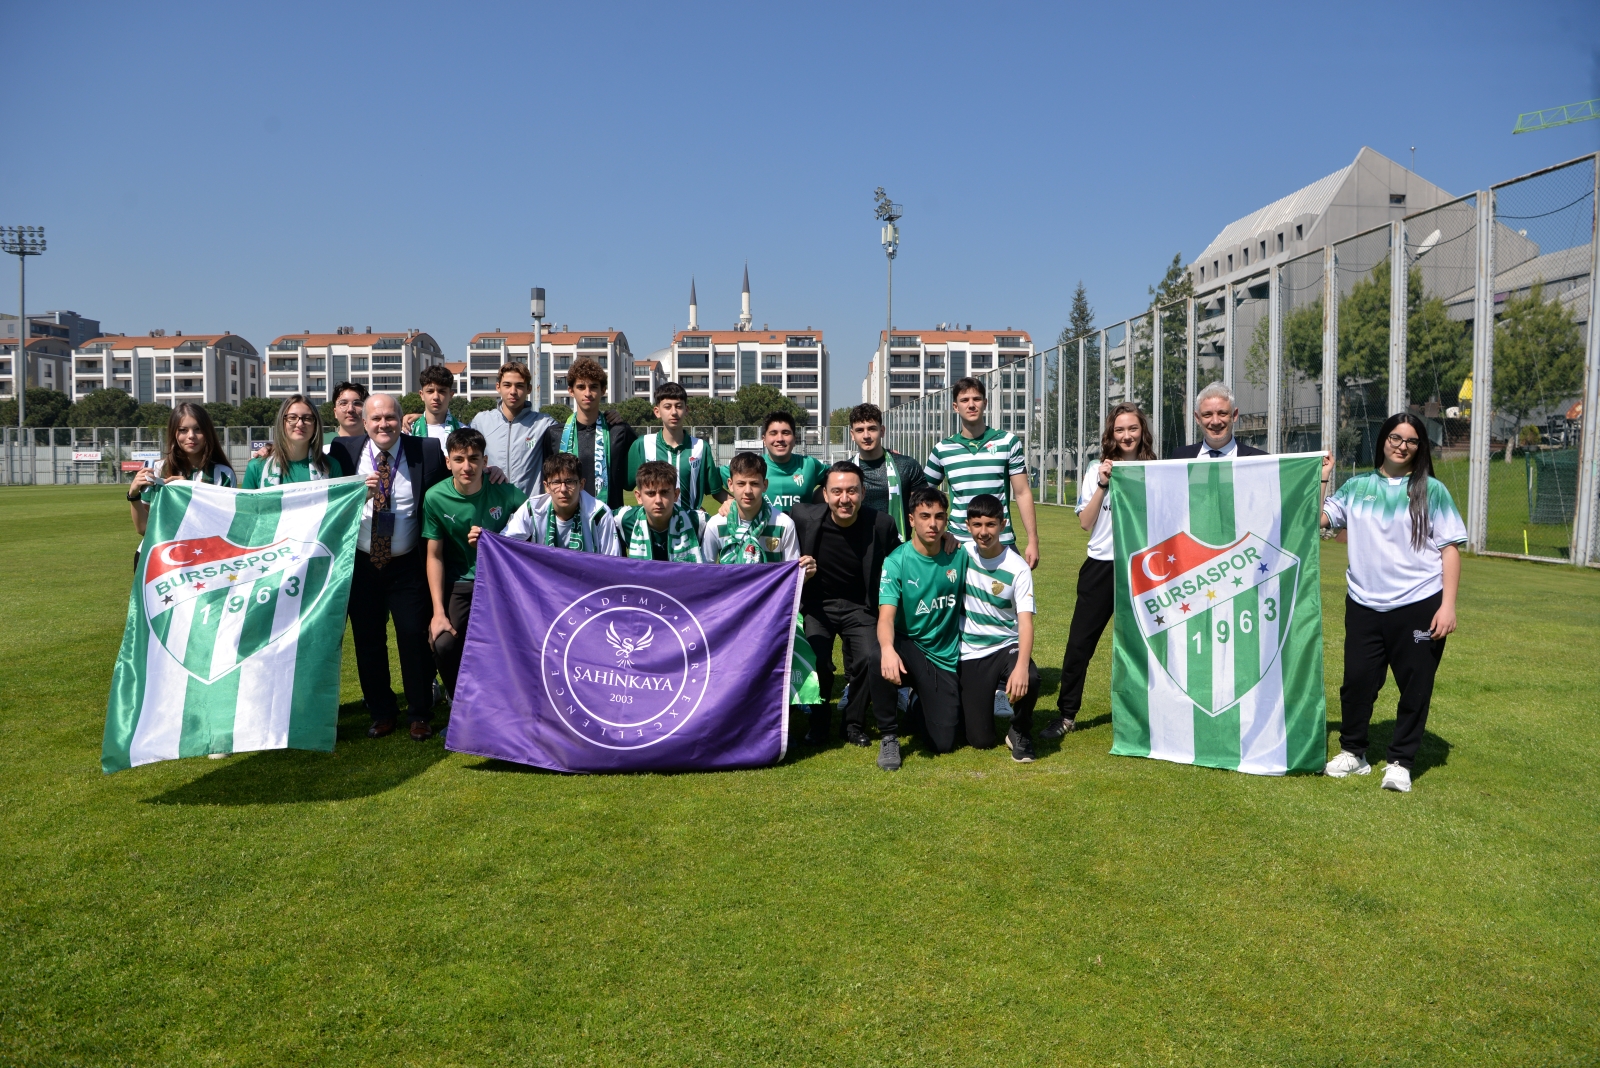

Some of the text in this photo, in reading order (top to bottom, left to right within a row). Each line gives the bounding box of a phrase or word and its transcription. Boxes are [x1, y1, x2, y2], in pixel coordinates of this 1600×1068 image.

[155, 546, 294, 596] BURSASPOR
[1144, 546, 1262, 614] BURSASPOR
[551, 594, 699, 739] ACADEMY FOR EXCELLENCE
[573, 666, 674, 692] ŞAHİNKAYA
[609, 693, 633, 704] 2003
